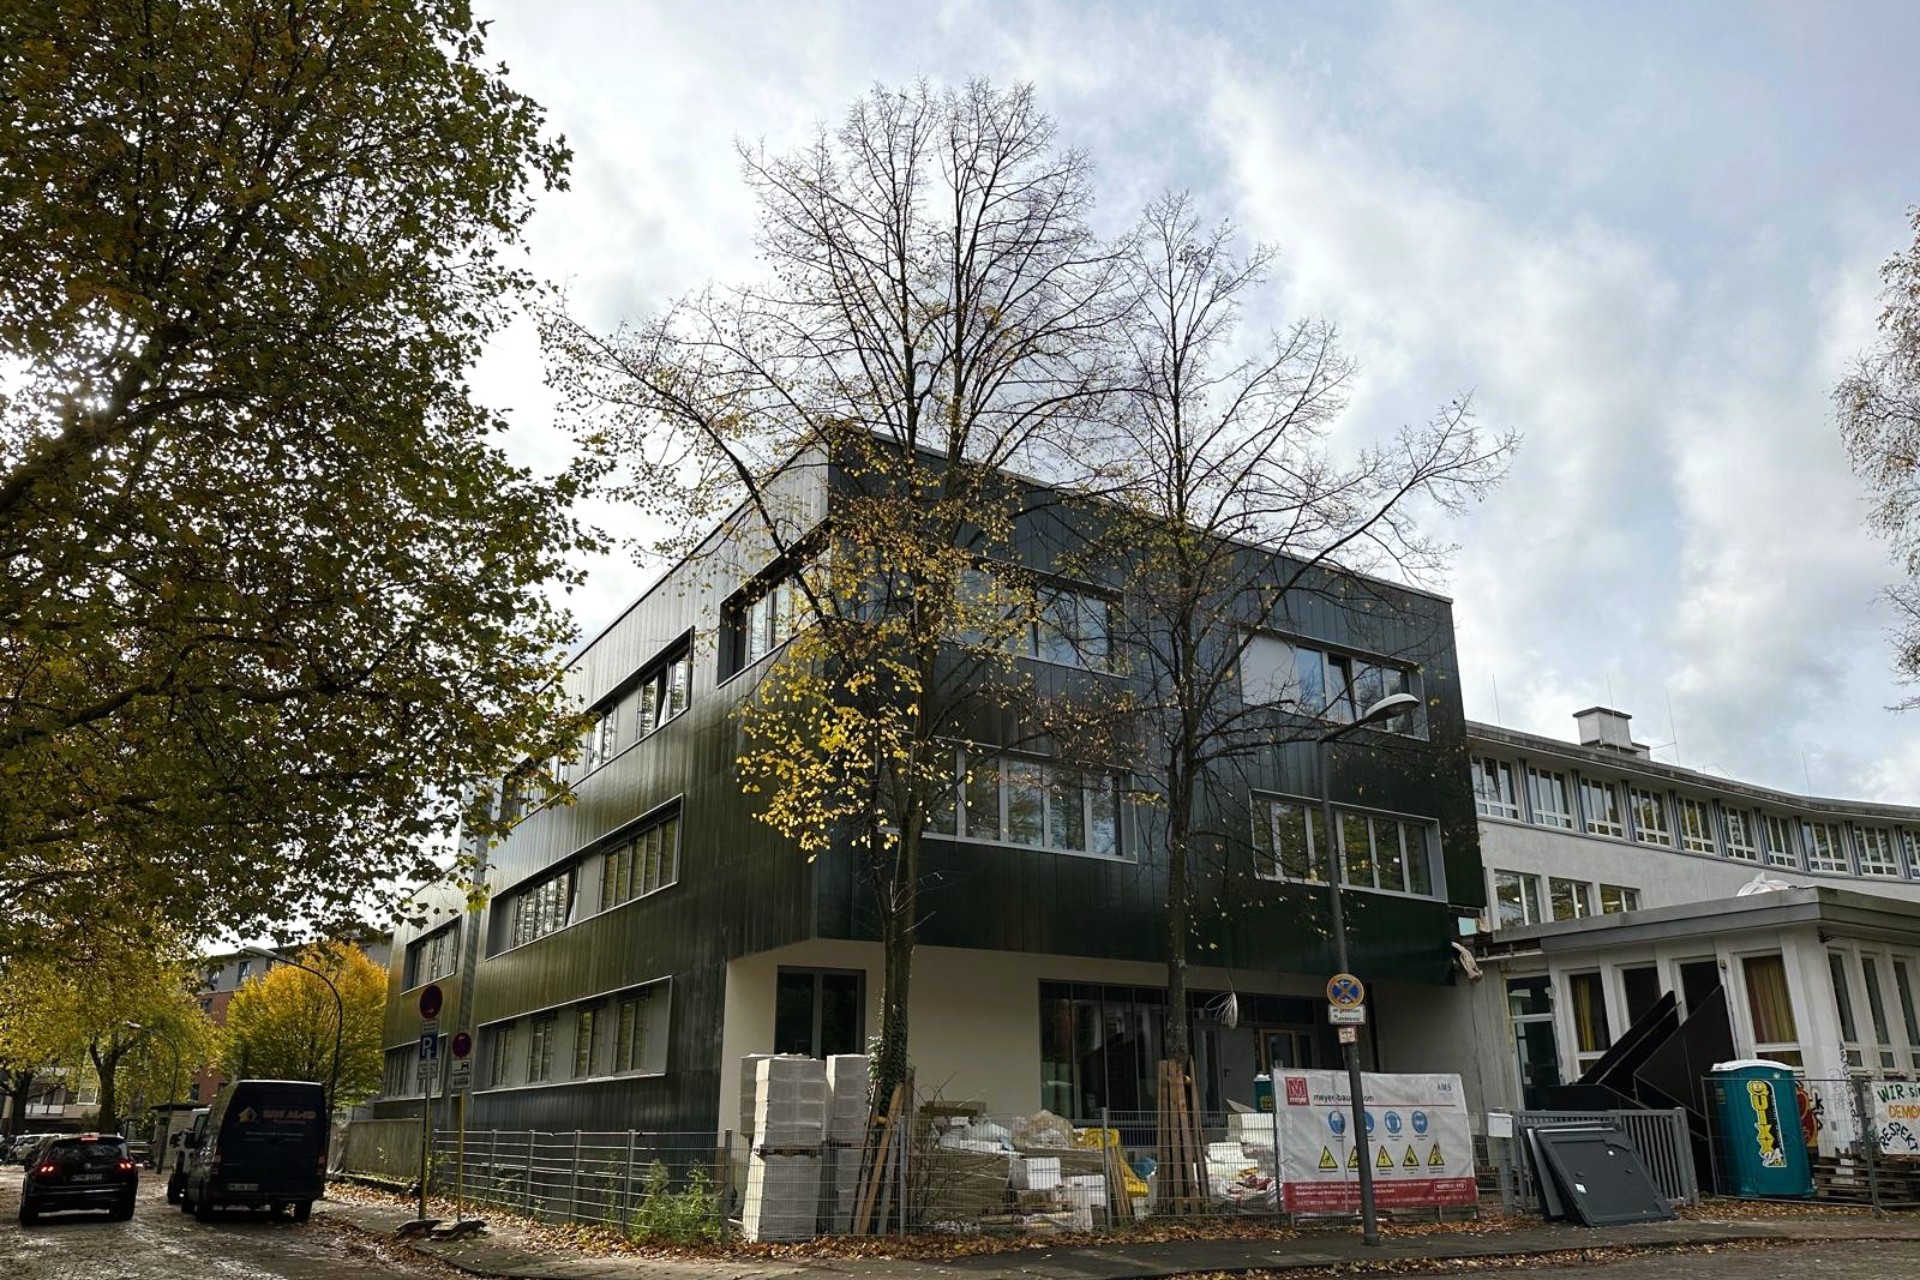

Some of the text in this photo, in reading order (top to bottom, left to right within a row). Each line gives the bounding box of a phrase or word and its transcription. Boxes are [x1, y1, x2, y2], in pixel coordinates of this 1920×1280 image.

[422, 1036, 433, 1057] P
[1877, 1084, 1905, 1103] WIR
[1888, 1104, 1920, 1119] DEMO
[1879, 1121, 1919, 1151] RESPEKT
